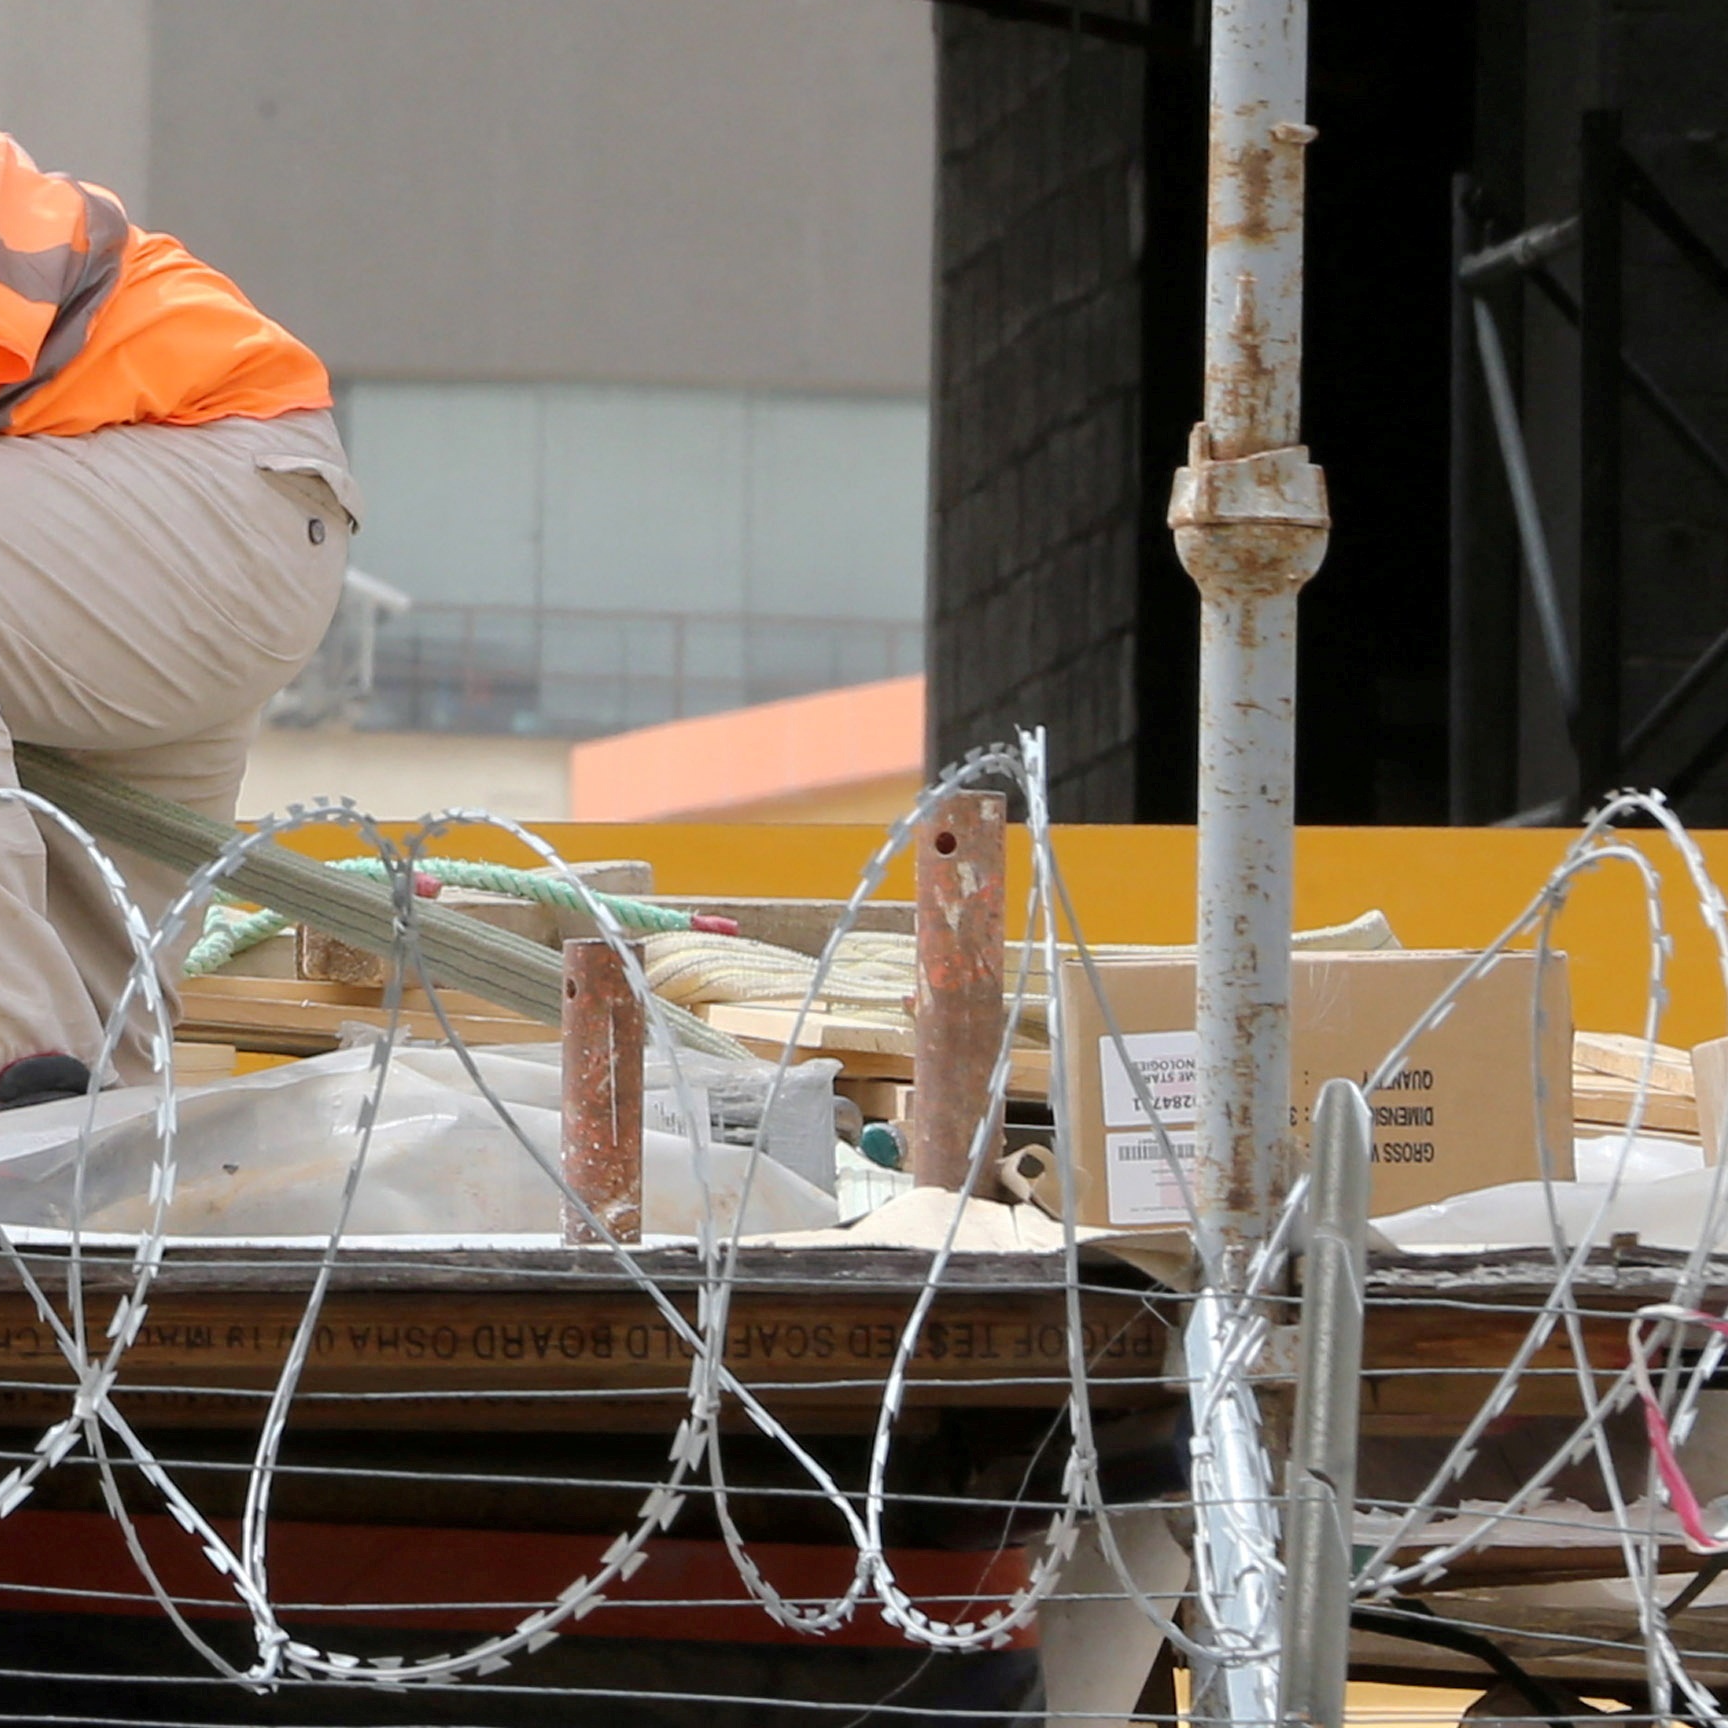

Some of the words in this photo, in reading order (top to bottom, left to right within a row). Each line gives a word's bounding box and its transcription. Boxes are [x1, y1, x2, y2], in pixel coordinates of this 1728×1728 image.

[1384, 1142, 1435, 1164] GROSS
[347, 1323, 458, 1361] OSHA
[472, 1323, 614, 1360] BOARD
